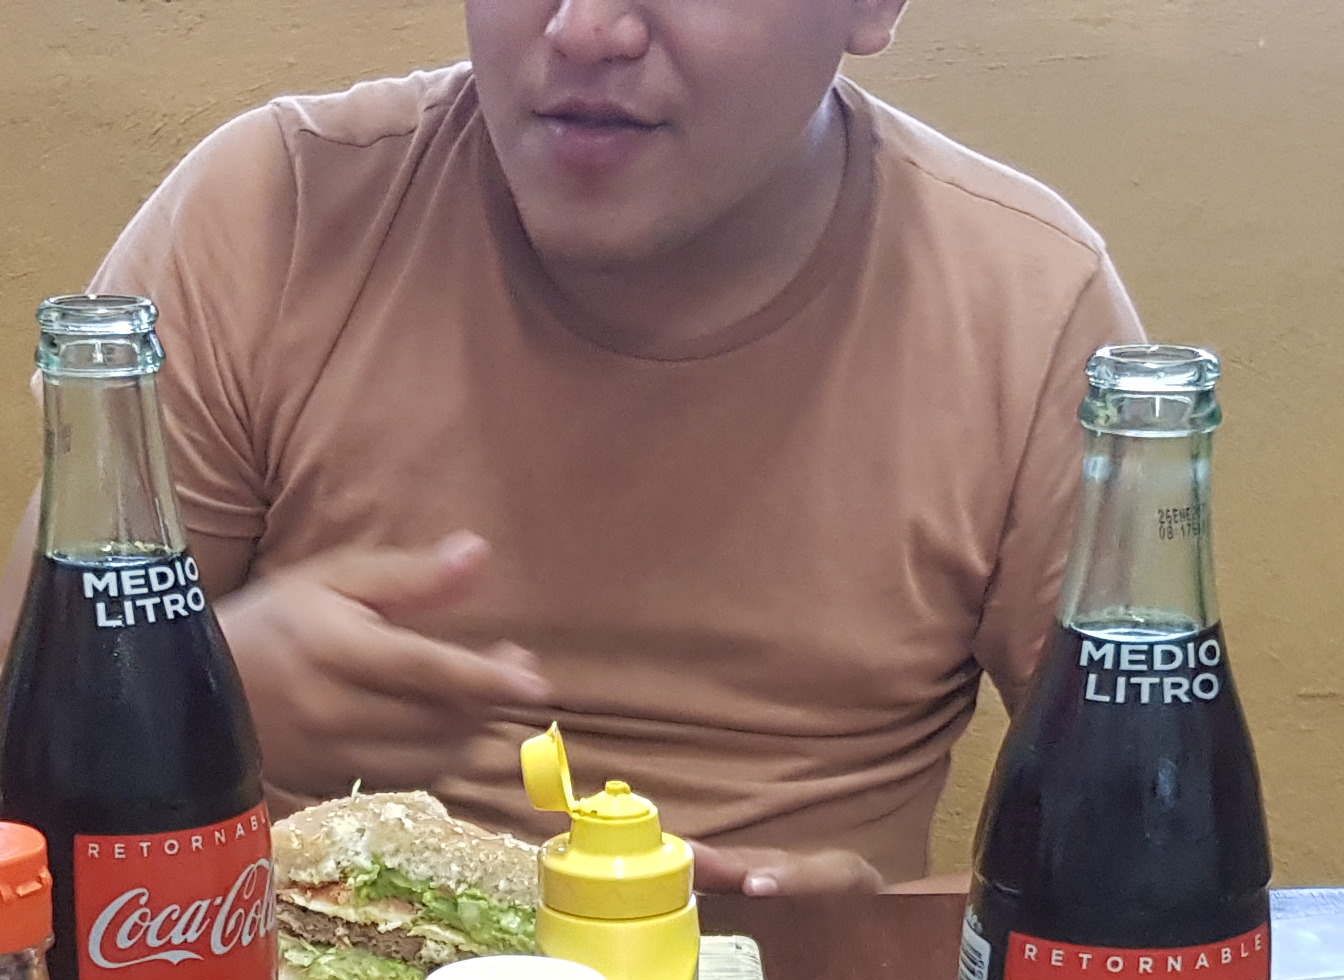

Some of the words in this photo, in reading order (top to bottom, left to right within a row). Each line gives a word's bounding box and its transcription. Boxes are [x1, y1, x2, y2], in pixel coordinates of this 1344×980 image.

[83, 557, 199, 598] MEDIO
[96, 587, 205, 627] LITRO
[1079, 639, 1221, 671] MEDIO
[1085, 673, 1219, 704] LITRO
[87, 811, 267, 858] RETORNABL
[1024, 934, 1263, 973] RETORNABLE
